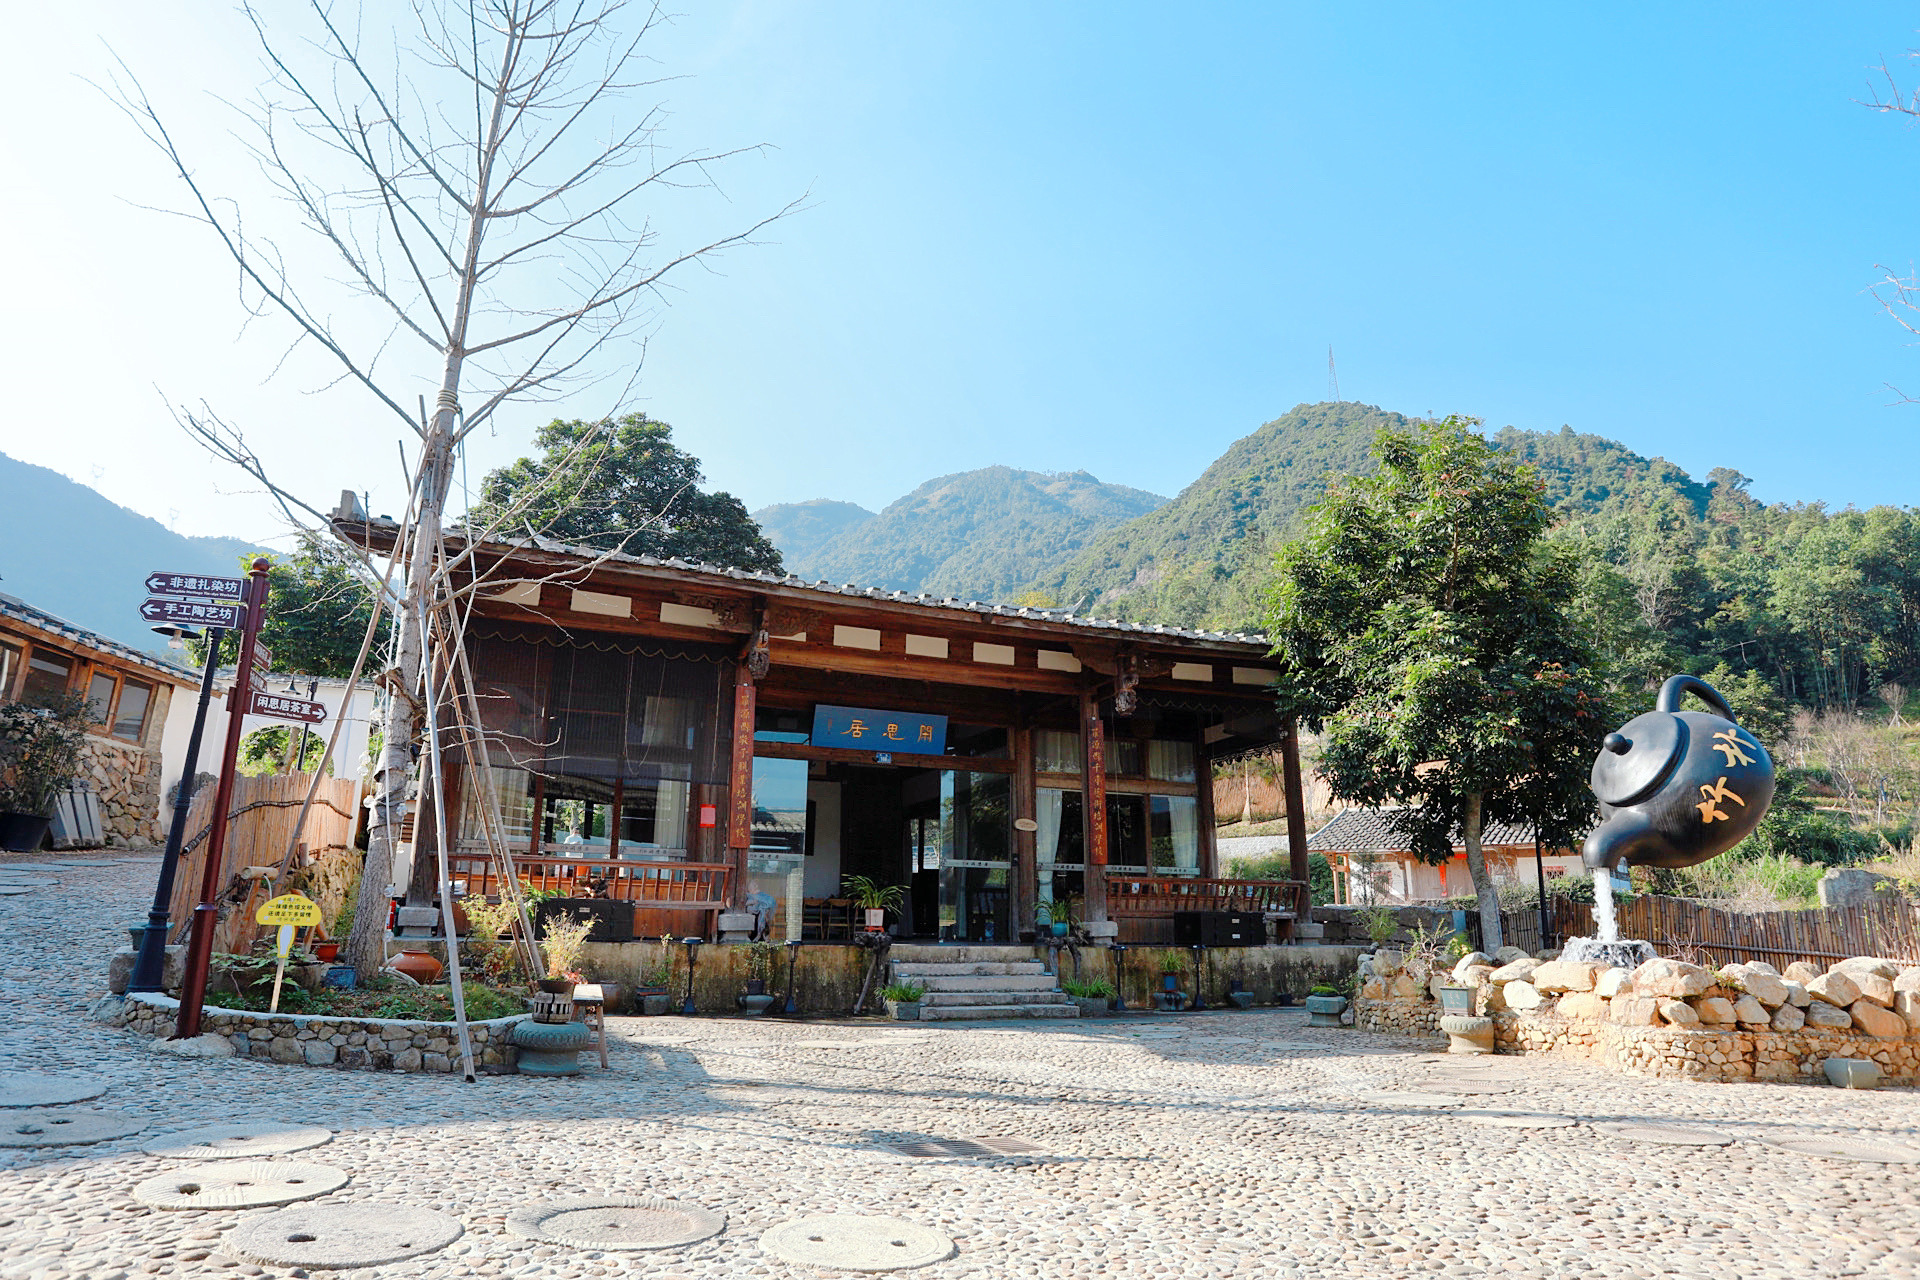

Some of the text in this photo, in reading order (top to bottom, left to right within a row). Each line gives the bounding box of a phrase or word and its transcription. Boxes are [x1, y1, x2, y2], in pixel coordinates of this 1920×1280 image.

[170, 577, 238, 593] 非遗扎染坊
[164, 603, 233, 619] 手工陶艺坊
[257, 696, 311, 715] 闲思居茶室
